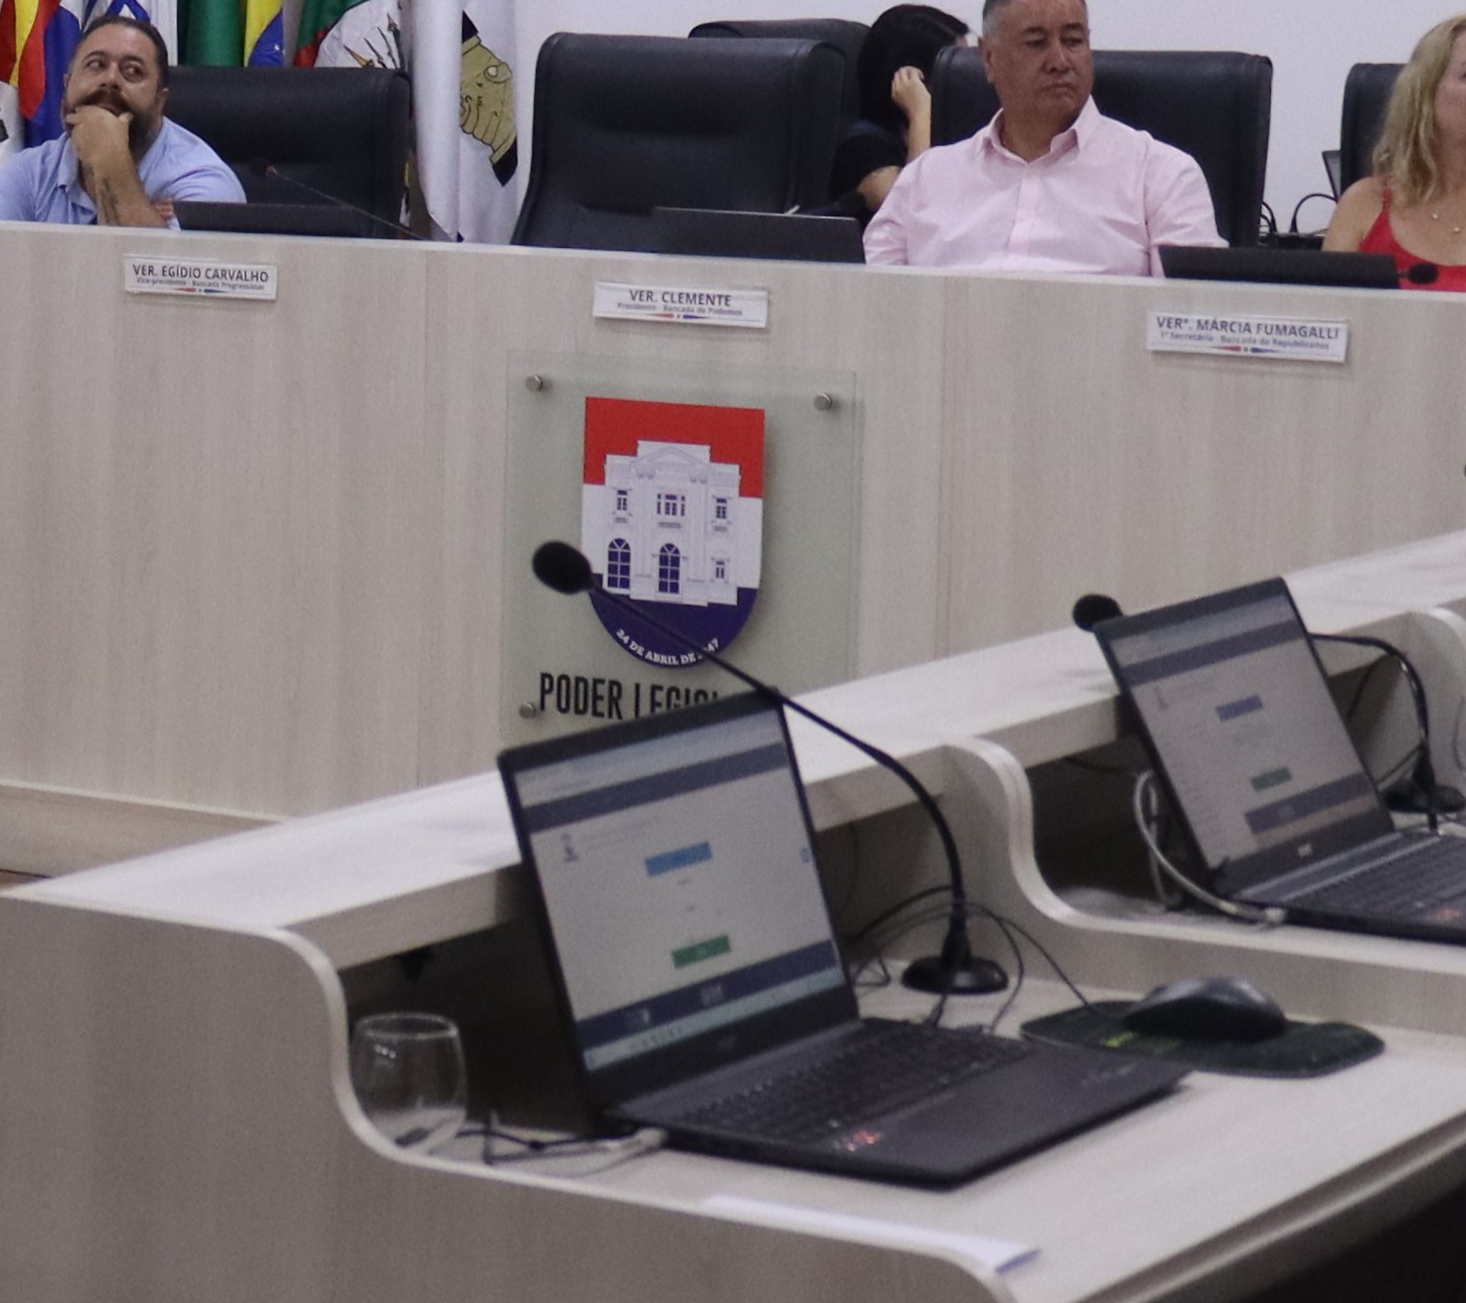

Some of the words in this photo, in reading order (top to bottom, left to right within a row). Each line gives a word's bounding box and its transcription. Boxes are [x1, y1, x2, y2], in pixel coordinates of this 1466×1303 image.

[132, 264, 158, 276] VER.
[161, 263, 201, 279] EGÍDIO
[205, 267, 269, 283] CARVALHO
[629, 289, 658, 303] VER.
[661, 291, 732, 307] CLEMENTE
[1196, 316, 1252, 335] MÁRCIA
[1256, 323, 1340, 340] FUMAGALLI
[616, 629, 631, 645] 24
[629, 640, 645, 656] DE
[644, 650, 680, 665] ABRIL
[679, 651, 697, 665] DE
[540, 671, 623, 720] PODER
